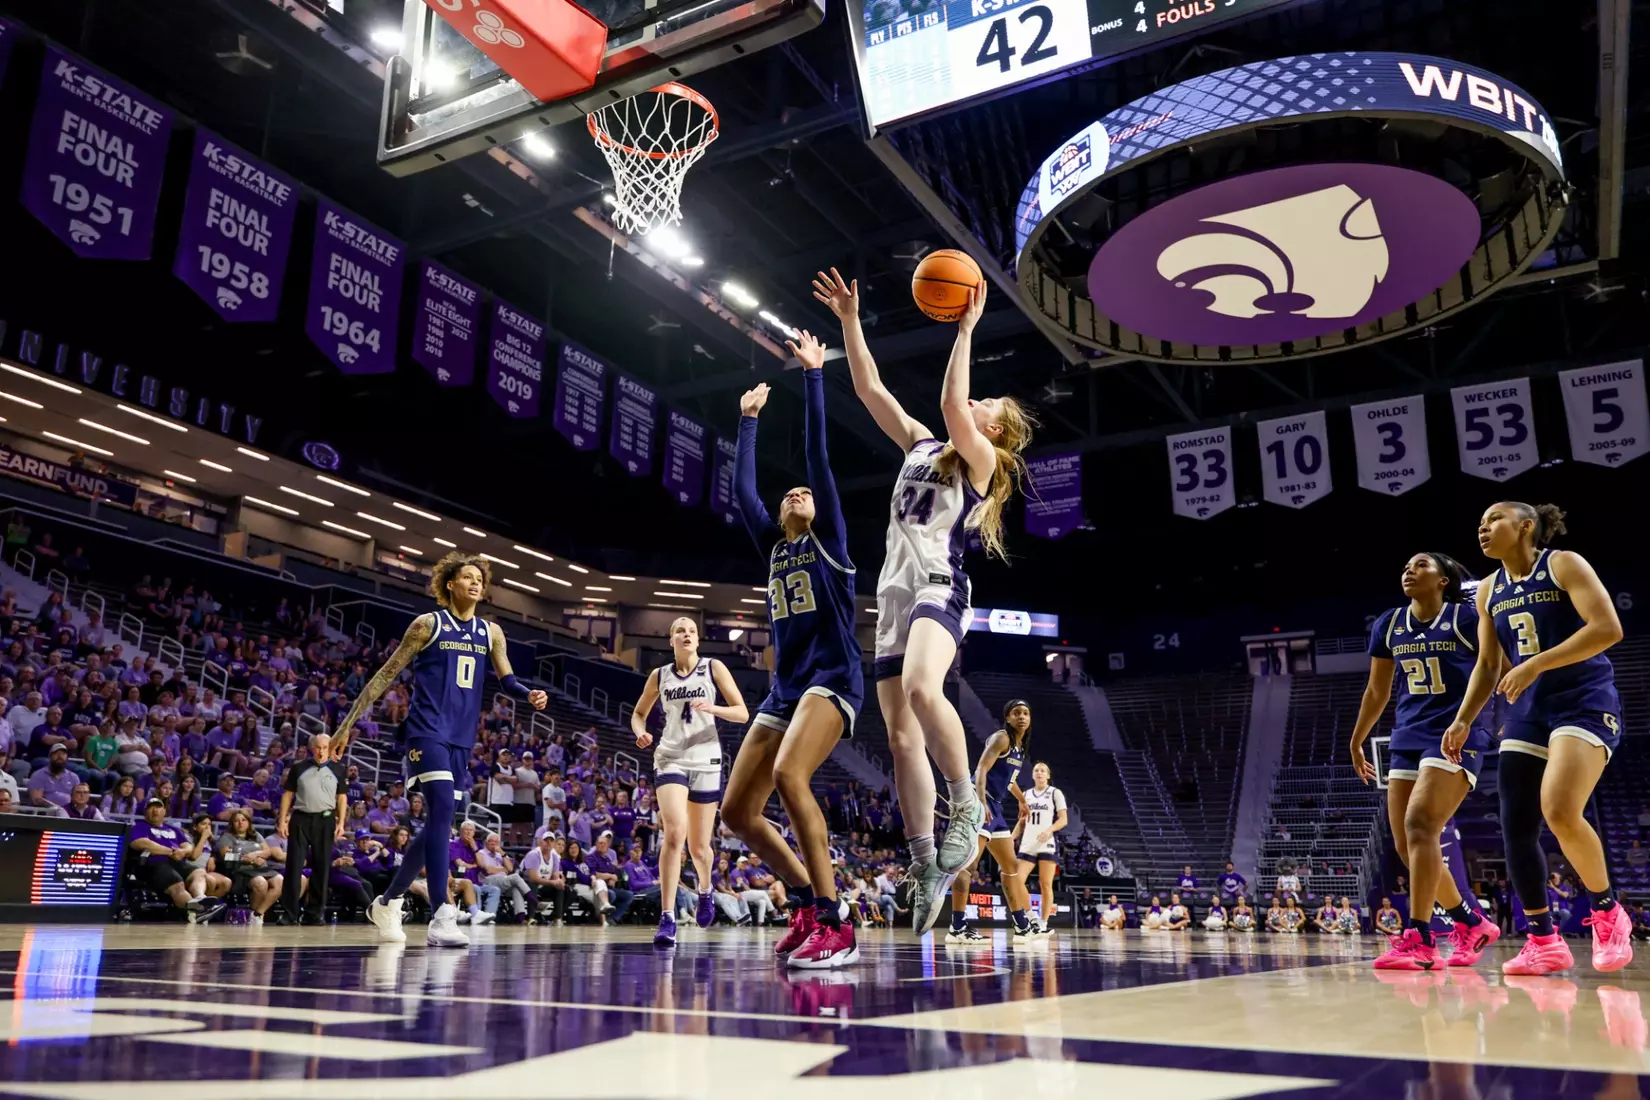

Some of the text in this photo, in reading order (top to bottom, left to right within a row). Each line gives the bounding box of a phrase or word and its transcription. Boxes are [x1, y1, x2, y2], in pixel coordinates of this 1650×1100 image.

[924, 12, 939, 27] FLS
[1134, 1, 1146, 14] 4
[1156, 1, 1216, 28] FOULS
[870, 30, 885, 45] PLY
[896, 21, 913, 36] PTS
[976, 5, 1058, 73] 42
[1091, 18, 1123, 35] BONUS
[1136, 19, 1148, 33] 4
[54, 59, 164, 130] K-STATE
[1398, 62, 1537, 132] WBIT
[93, 97, 152, 136] BASKETBALL
[61, 109, 139, 168] FINAL
[56, 131, 135, 188] FOUR
[202, 141, 291, 201] K-STATE
[48, 174, 135, 236] 1951
[209, 187, 273, 238] FINAL
[205, 208, 268, 256] FOUR
[324, 210, 400, 262] K-STATE
[198, 245, 269, 299] 1958
[330, 251, 384, 296] FINAL
[425, 266, 477, 302] K-STATE
[327, 270, 381, 313] FOUR
[320, 305, 381, 354] 1964
[448, 309, 472, 329] EIGHT
[497, 304, 543, 338] K-STATE
[493, 349, 542, 382] CHAMPIONS
[494, 339, 542, 370] CONFERENCE
[563, 345, 604, 375] K-STATE
[498, 370, 533, 400] 2019
[618, 375, 656, 403] K-STATE
[1571, 369, 1633, 389] LEHNING
[1464, 387, 1519, 405] WECKER
[1592, 388, 1624, 433] 5
[1366, 405, 1409, 421] OHLDE
[1464, 403, 1529, 451] 53
[1172, 434, 1225, 450] ROMSTAD
[1275, 422, 1307, 436] GARY
[1376, 422, 1406, 464] 3
[1588, 437, 1636, 451] 2005-09
[1175, 449, 1228, 492] 33
[1267, 435, 1323, 480] 10
[1477, 453, 1522, 466] 2001-05
[1279, 481, 1317, 495] 1981-83
[1374, 468, 1416, 482] 2000-04
[898, 486, 936, 526] 34
[1185, 494, 1221, 507] 1979-82
[790, 551, 817, 567] TECH
[768, 569, 817, 622] 33
[1526, 590, 1561, 605] TECH
[439, 641, 473, 653] GEORGIA
[1152, 633, 1181, 651] 24
[1391, 641, 1457, 656] GEORGIA TECH
[1508, 611, 1541, 657] 3
[456, 655, 477, 689] 0
[1400, 656, 1447, 695] 21
[664, 686, 706, 702] Wildcats
[681, 701, 693, 724] 4
[1032, 812, 1041, 825] 11
